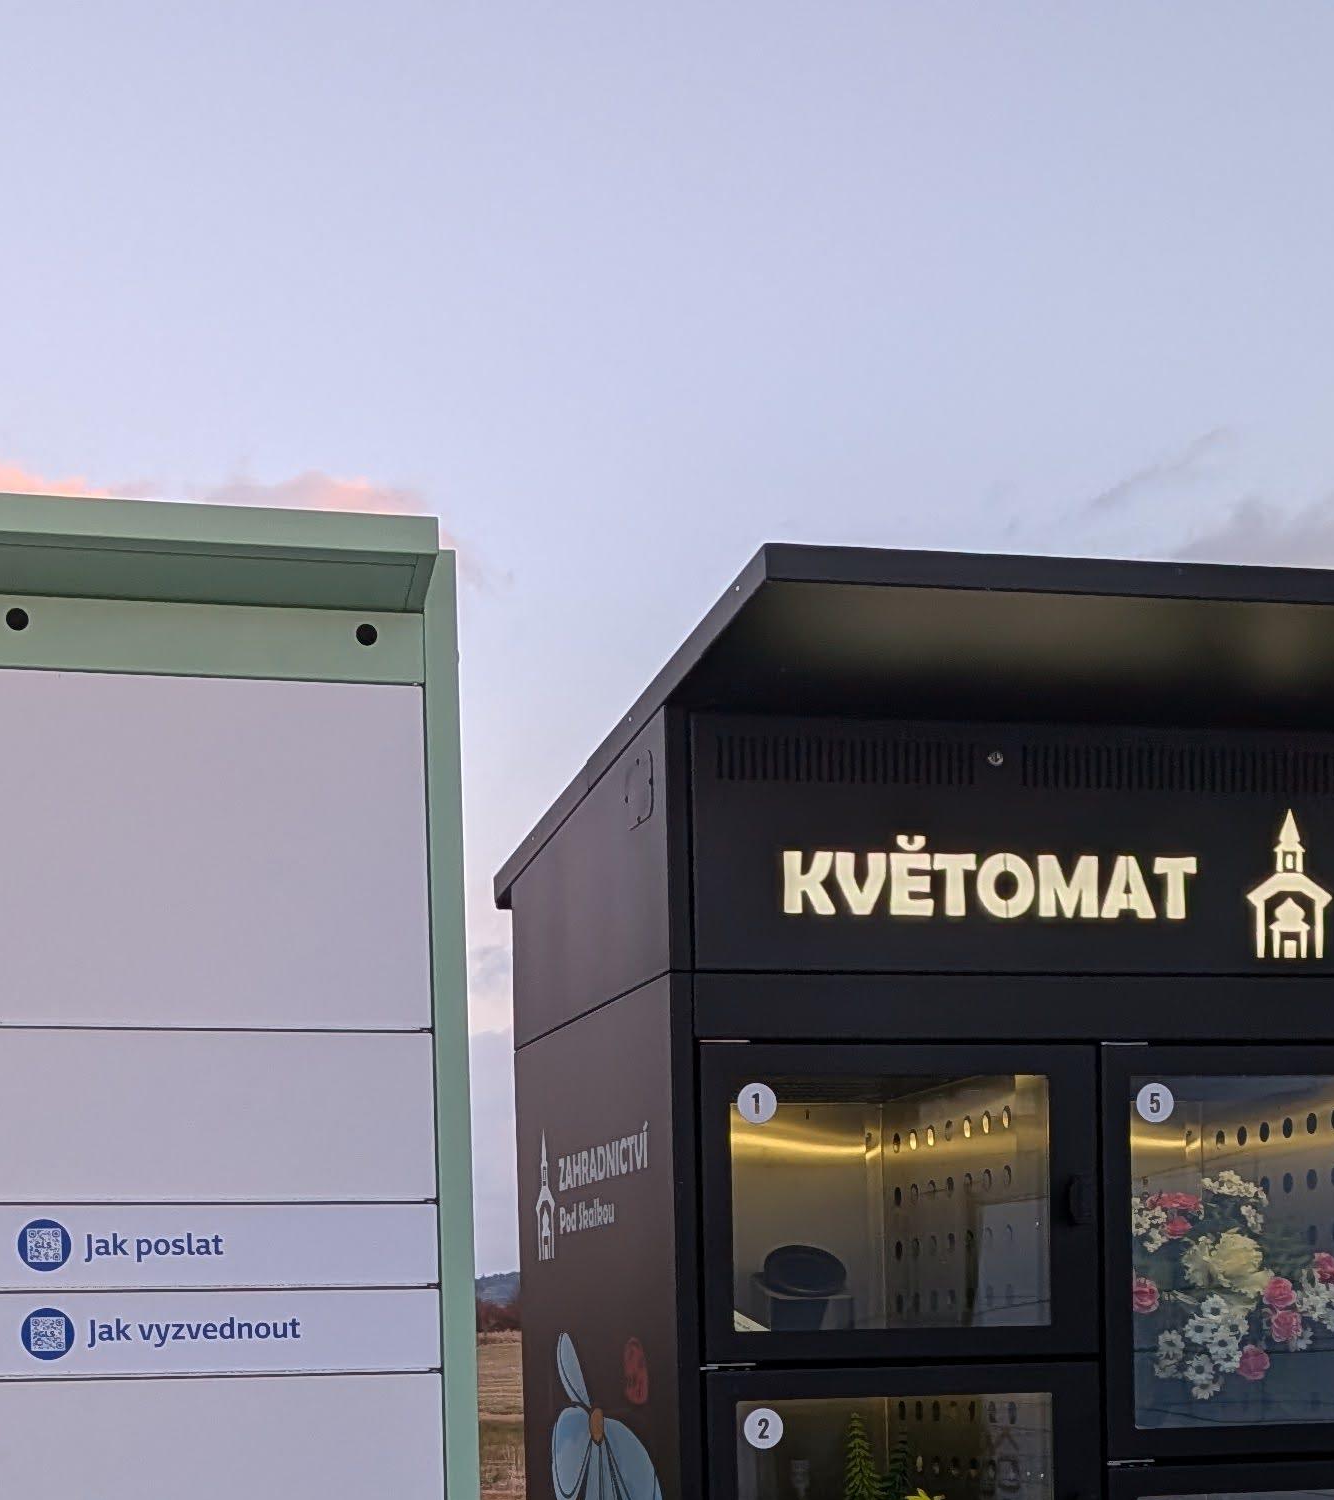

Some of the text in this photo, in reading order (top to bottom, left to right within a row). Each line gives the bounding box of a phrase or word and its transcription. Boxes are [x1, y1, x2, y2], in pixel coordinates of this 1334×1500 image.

[783, 834, 1198, 920] KVĚTOMAT
[751, 1092, 760, 1115] 1
[1149, 1092, 1161, 1114] 5
[558, 1120, 649, 1191] ZAHRADNICTVÍ
[559, 1197, 615, 1235] Pod Skalkou
[84, 1232, 224, 1263] Jak poslat
[87, 1316, 301, 1348] Jak vyzvednout
[757, 1417, 770, 1440] 2
